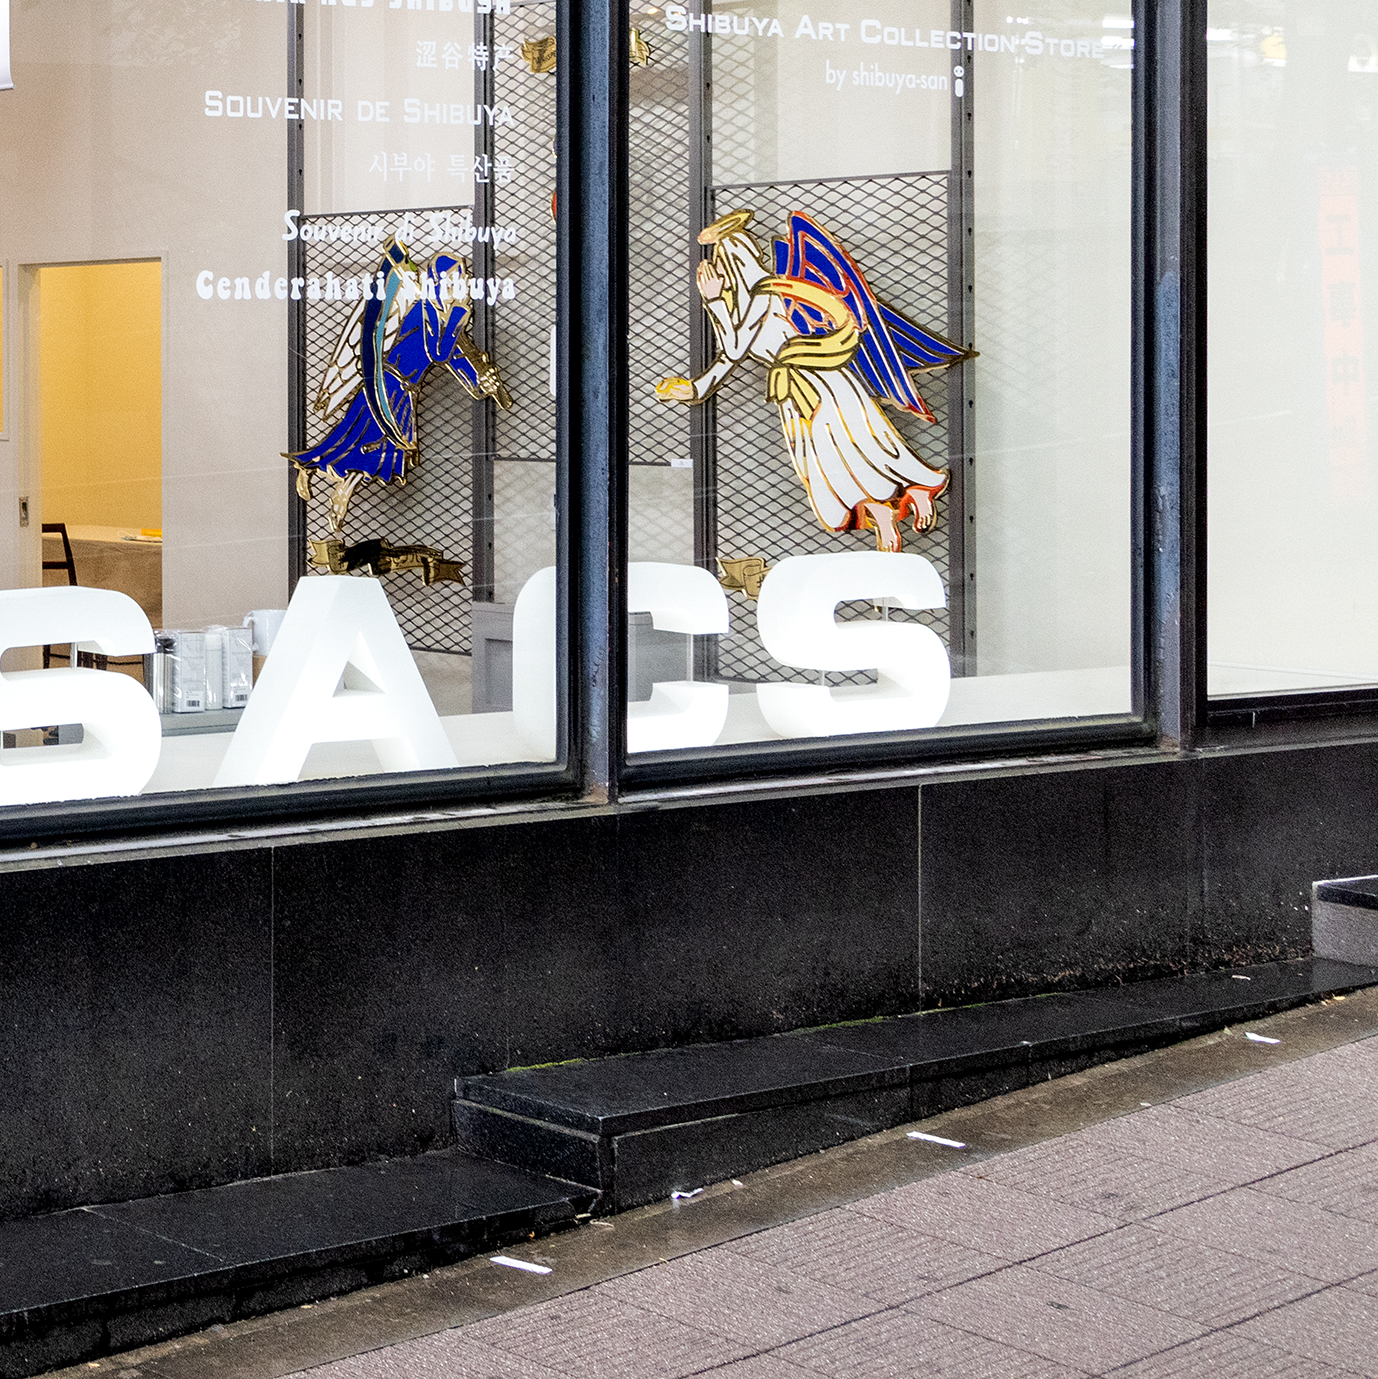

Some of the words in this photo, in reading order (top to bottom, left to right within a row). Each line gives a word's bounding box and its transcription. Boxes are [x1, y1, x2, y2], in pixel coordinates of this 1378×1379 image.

[665, 5, 783, 38] SHIBUYA
[795, 14, 850, 42] ART
[860, 18, 1017, 54] COLLECTION
[1024, 31, 1106, 59] STORE
[415, 40, 514, 72] 涩谷特产
[825, 60, 846, 92] by
[852, 63, 947, 95] shibuya-san
[204, 90, 343, 122] SOUVENIR
[356, 100, 390, 123] DE
[402, 97, 515, 127] SHIBUYA
[368, 150, 436, 182] 시부야
[281, 209, 385, 245] Souvenir
[394, 214, 415, 243] di
[425, 211, 517, 250] Shibuya
[195, 270, 386, 302] Cenderahati
[400, 270, 516, 307] Shibuya
